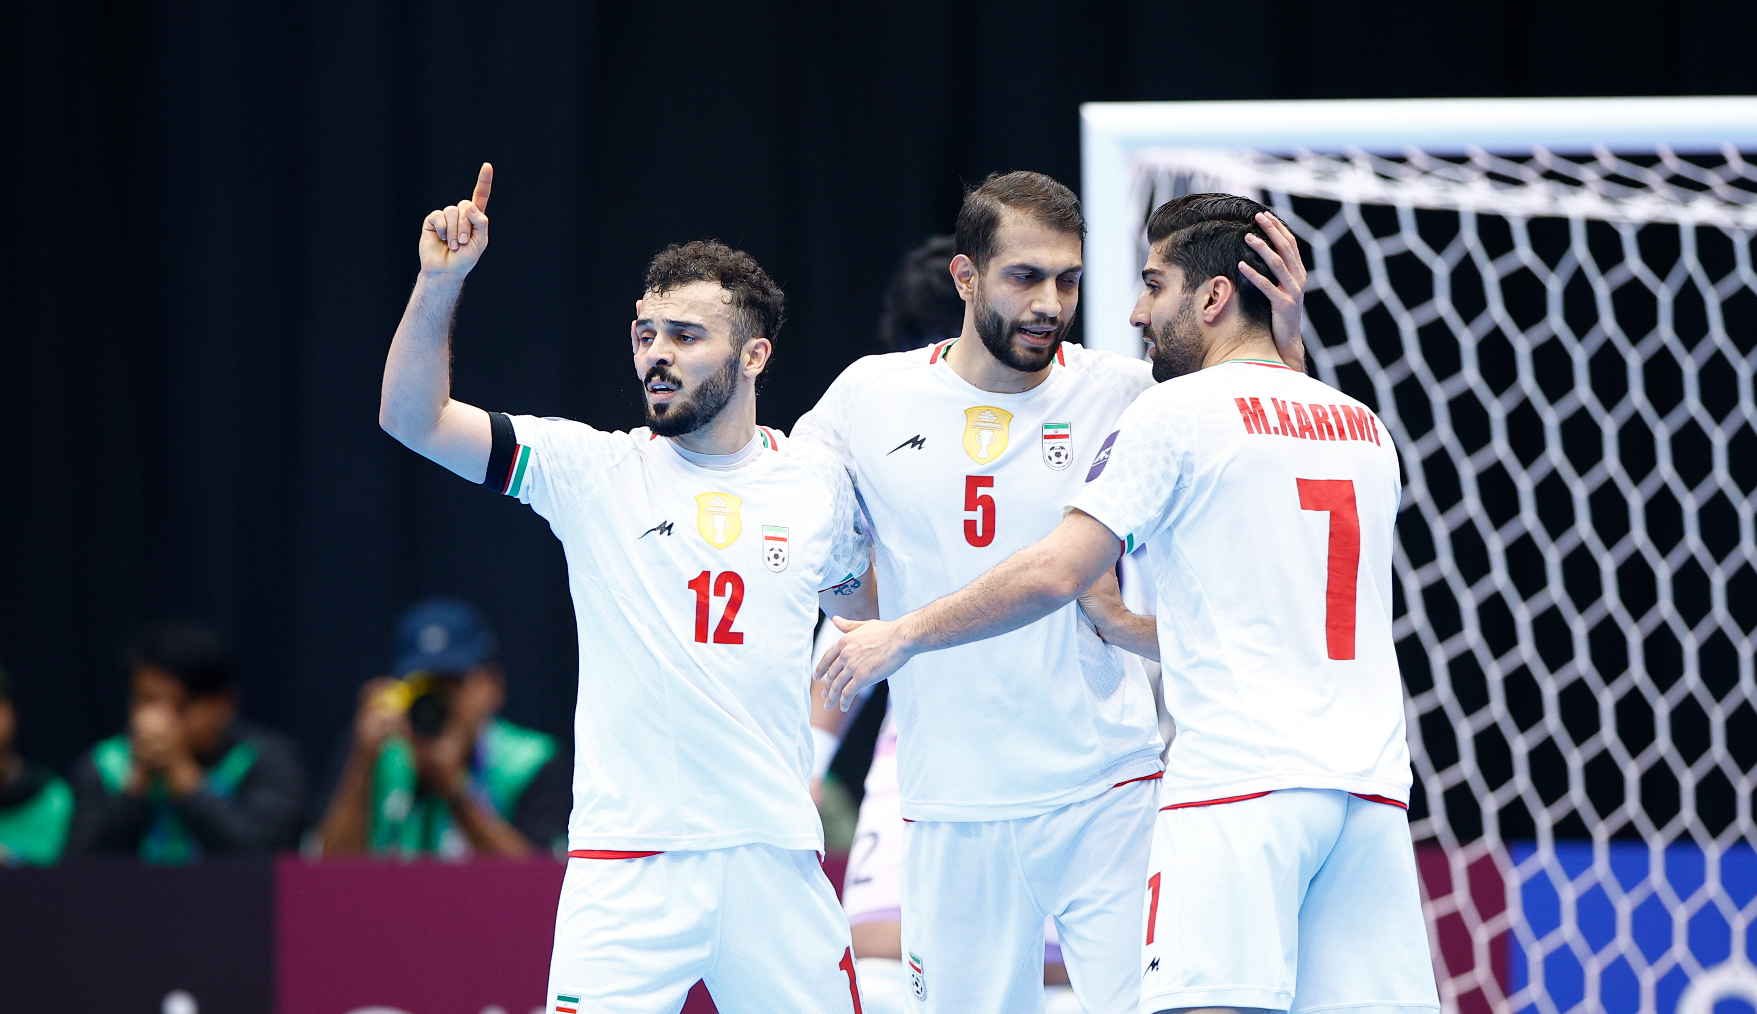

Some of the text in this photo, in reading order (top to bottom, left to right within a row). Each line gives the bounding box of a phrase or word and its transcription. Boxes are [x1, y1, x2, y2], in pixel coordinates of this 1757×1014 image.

[1233, 396, 1381, 448] M.KARIMI
[963, 475, 996, 548] 5
[1295, 477, 1361, 661] 7
[687, 570, 745, 645] 12
